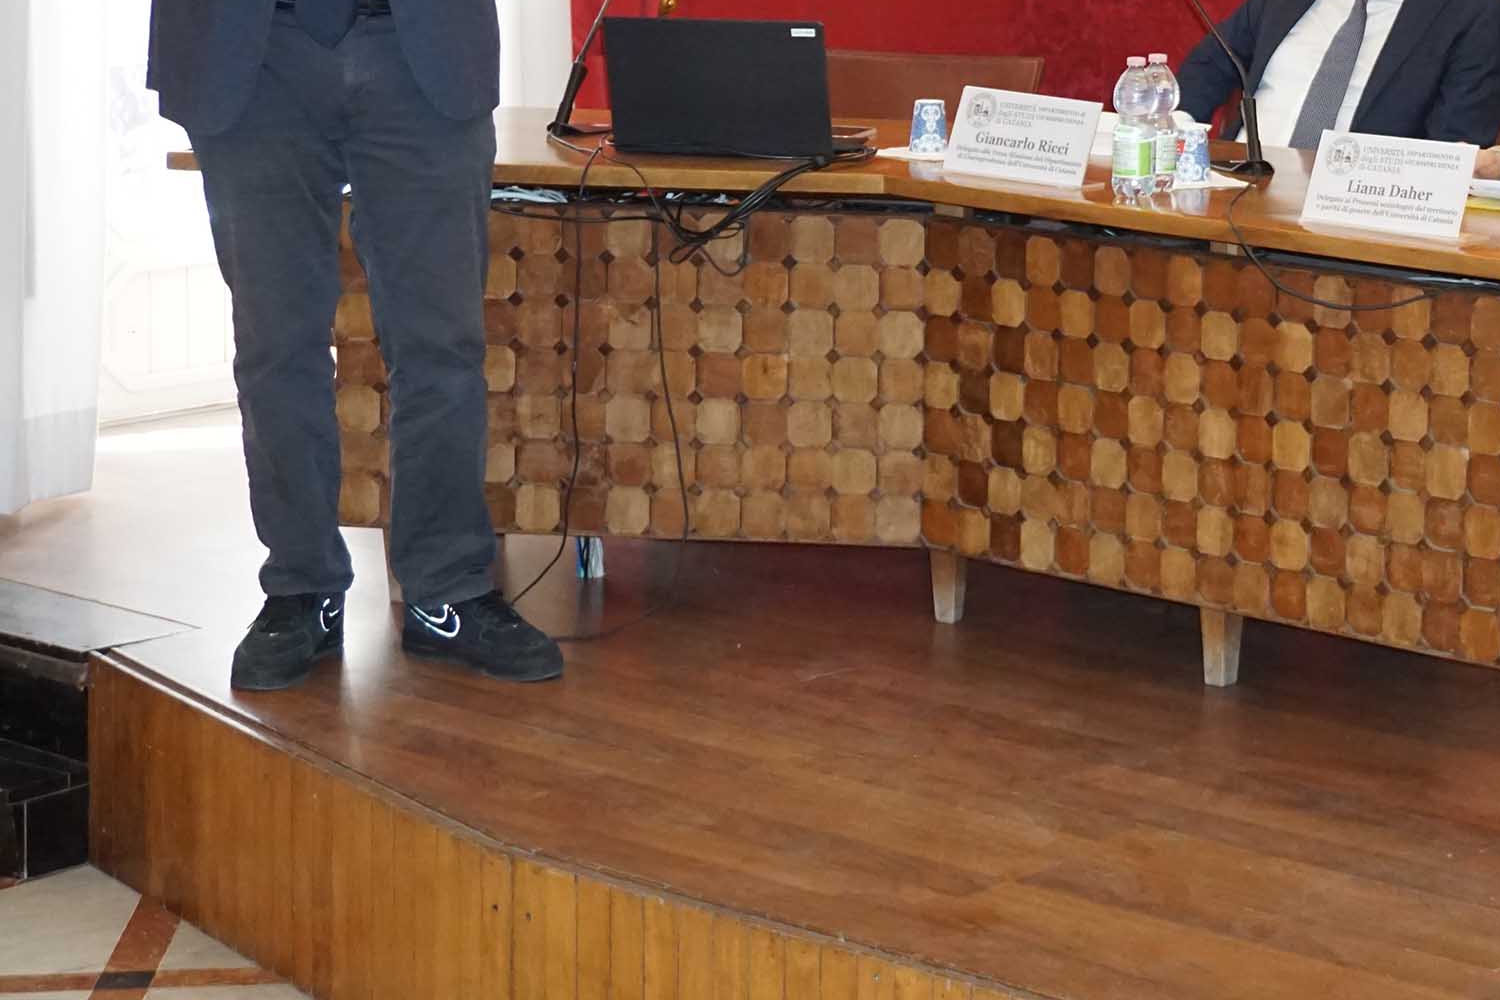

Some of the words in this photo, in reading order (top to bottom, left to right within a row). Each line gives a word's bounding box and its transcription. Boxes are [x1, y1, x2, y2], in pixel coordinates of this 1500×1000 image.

[975, 131, 1035, 151] Giancarlo
[1038, 140, 1069, 155] Ricci
[1347, 179, 1385, 197] Liana
[1390, 184, 1433, 201] Daher
